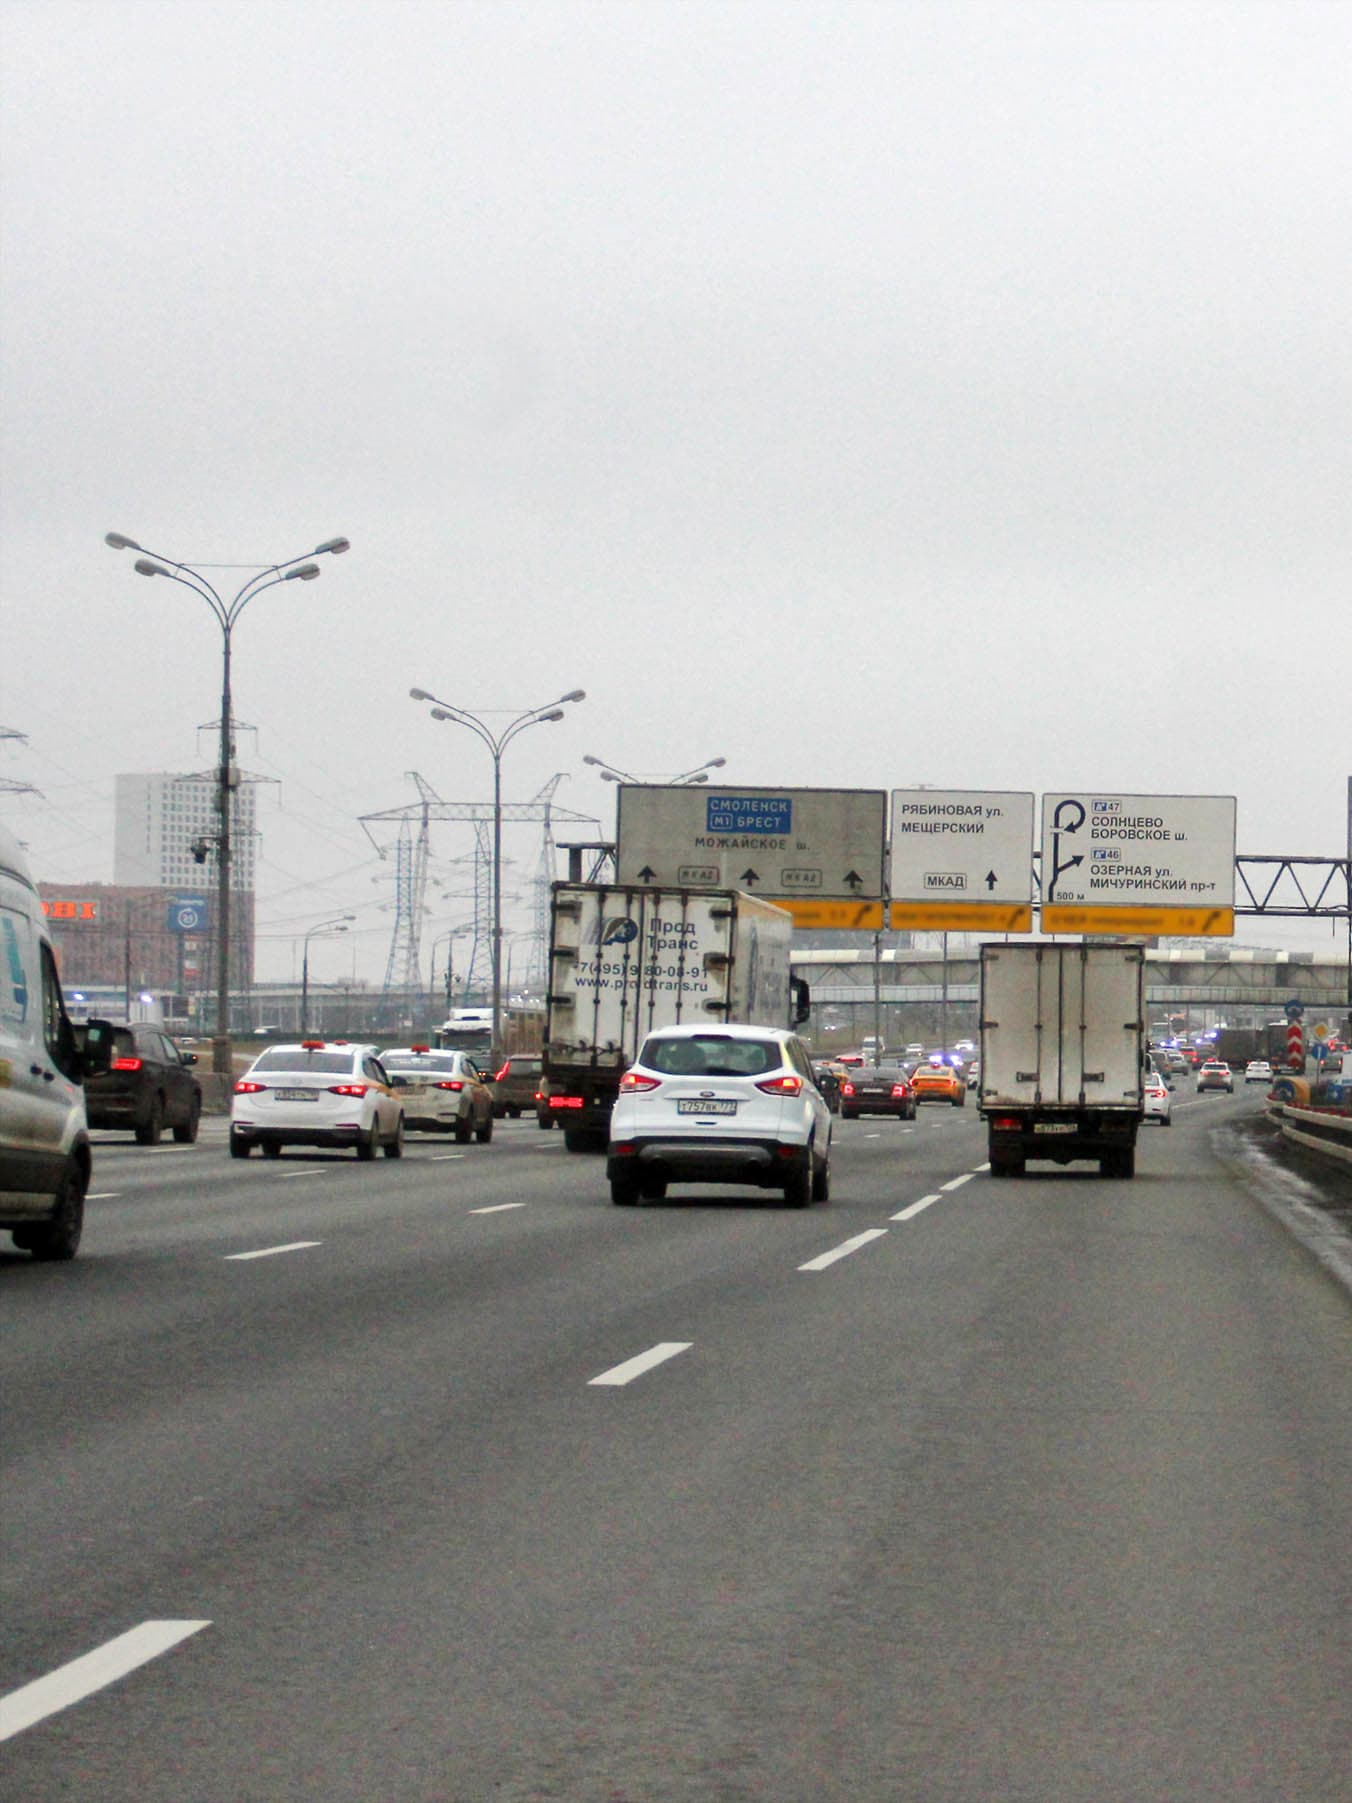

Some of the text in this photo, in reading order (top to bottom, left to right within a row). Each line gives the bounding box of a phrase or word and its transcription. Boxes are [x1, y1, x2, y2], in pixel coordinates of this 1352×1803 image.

[710, 799, 788, 813] СМОЛЕНСК
[902, 804, 1004, 818] РЯБИНОВАЯ ул.
[1108, 802, 1120, 811] 47
[737, 816, 781, 828] БРЕСТ
[901, 822, 984, 834] МЕЩЕРСКИЙ
[1091, 816, 1163, 829] СОЛНЦЕВО
[1091, 828, 1188, 841] БОРОВСКОЕ ш.
[695, 836, 786, 850] МОЖАЙСКОЕ
[1107, 850, 1119, 859] 46
[1090, 864, 1173, 878] ОЗЕРНАЯ ул.
[927, 876, 964, 887] МКАД
[1090, 877, 1216, 892] МИЧУРИНСКИЙ пр-т
[1056, 892, 1074, 900] 500
[650, 918, 696, 936] Прод
[647, 935, 698, 951] Транс
